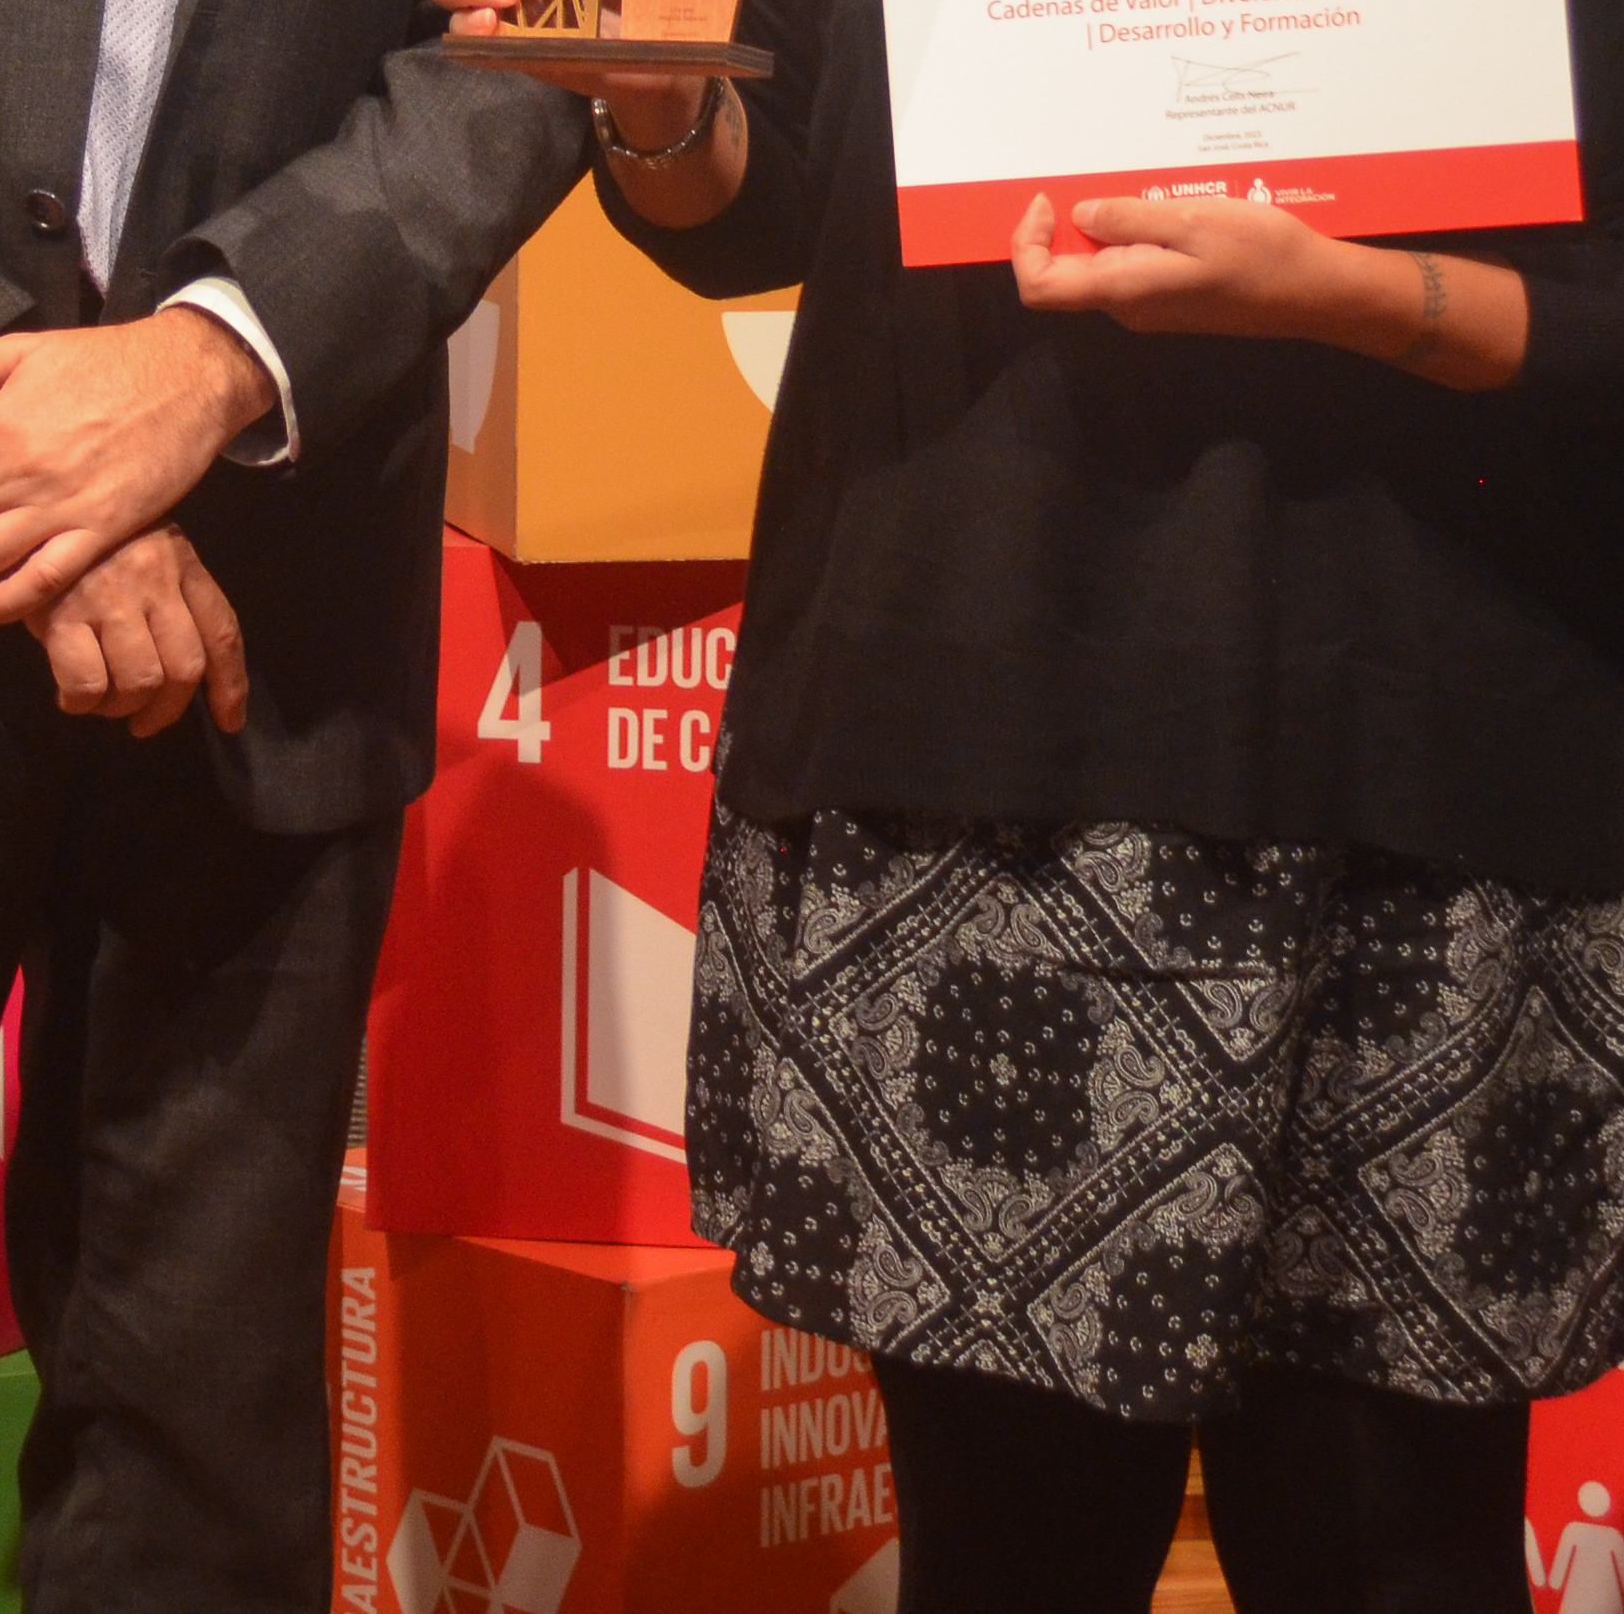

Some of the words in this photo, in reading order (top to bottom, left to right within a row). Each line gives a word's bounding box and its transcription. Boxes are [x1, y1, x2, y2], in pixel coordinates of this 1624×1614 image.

[1099, 16, 1216, 44] Desarrollo
[1221, 19, 1233, 40] y
[1240, 6, 1361, 34] Formación
[1171, 181, 1227, 197] UNHCR
[608, 625, 736, 690] EDUC
[477, 621, 551, 764] 4
[607, 707, 668, 770] DE
[671, 1339, 727, 1488] 9
[761, 1462, 895, 1549] INFRAE
